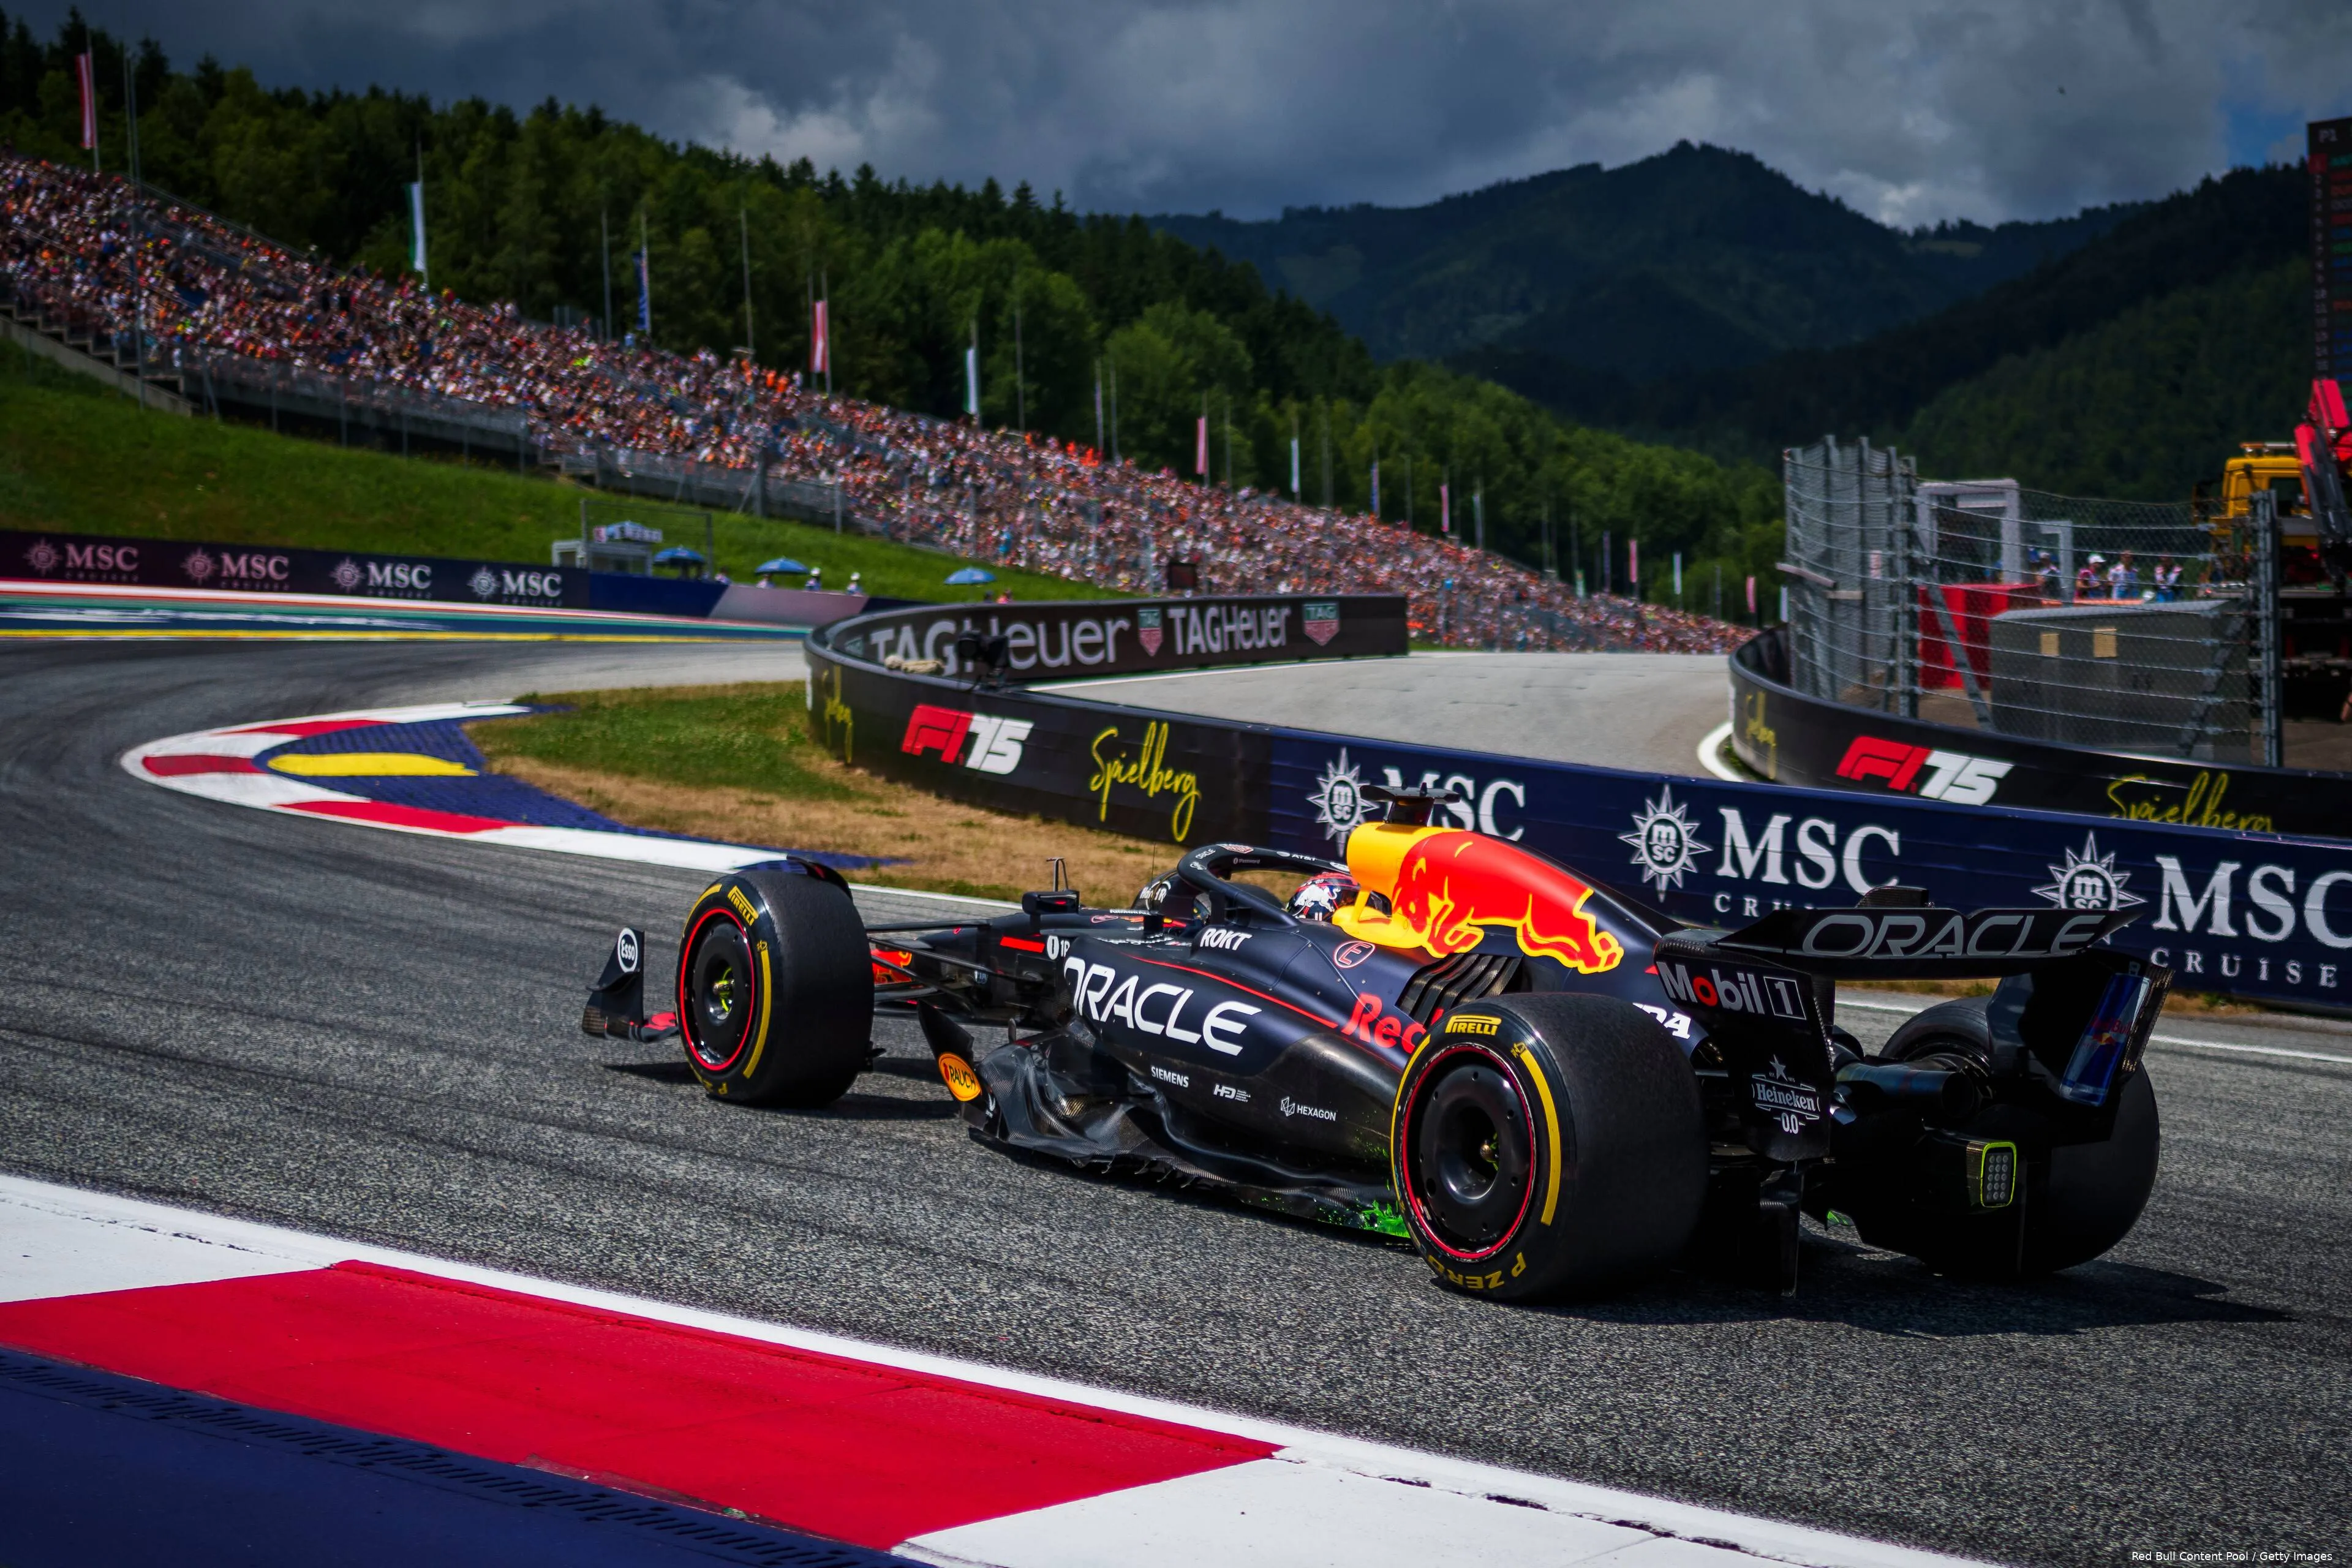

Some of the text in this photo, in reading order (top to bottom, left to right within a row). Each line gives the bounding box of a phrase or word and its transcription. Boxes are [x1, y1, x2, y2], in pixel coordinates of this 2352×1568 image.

[64, 543, 139, 572] MSC
[221, 551, 289, 581] MSC
[366, 562, 432, 589] MSC
[502, 570, 562, 598] MSC
[1089, 721, 1202, 843] Spielberg
[1716, 806, 1899, 896] MSC
[727, 885, 760, 927] PIRELLI
[2152, 854, 2352, 949] MSC
[621, 939, 635, 961] Esso
[1200, 928, 1253, 951] ROKT
[1803, 914, 2106, 958] ORACLE
[2150, 947, 2338, 988] CRUISE
[1656, 961, 1793, 1015] Mobil 1
[1445, 1014, 1502, 1036] PIRELLI
[948, 1065, 976, 1091] RAUCH
[1151, 1066, 1189, 1088] SIEMENS
[1755, 1083, 1816, 1112] Heineken
[1297, 1104, 1336, 1122] HEXAGON
[1781, 1112, 1799, 1134] 0.0
[1511, 1251, 1526, 1278] P
